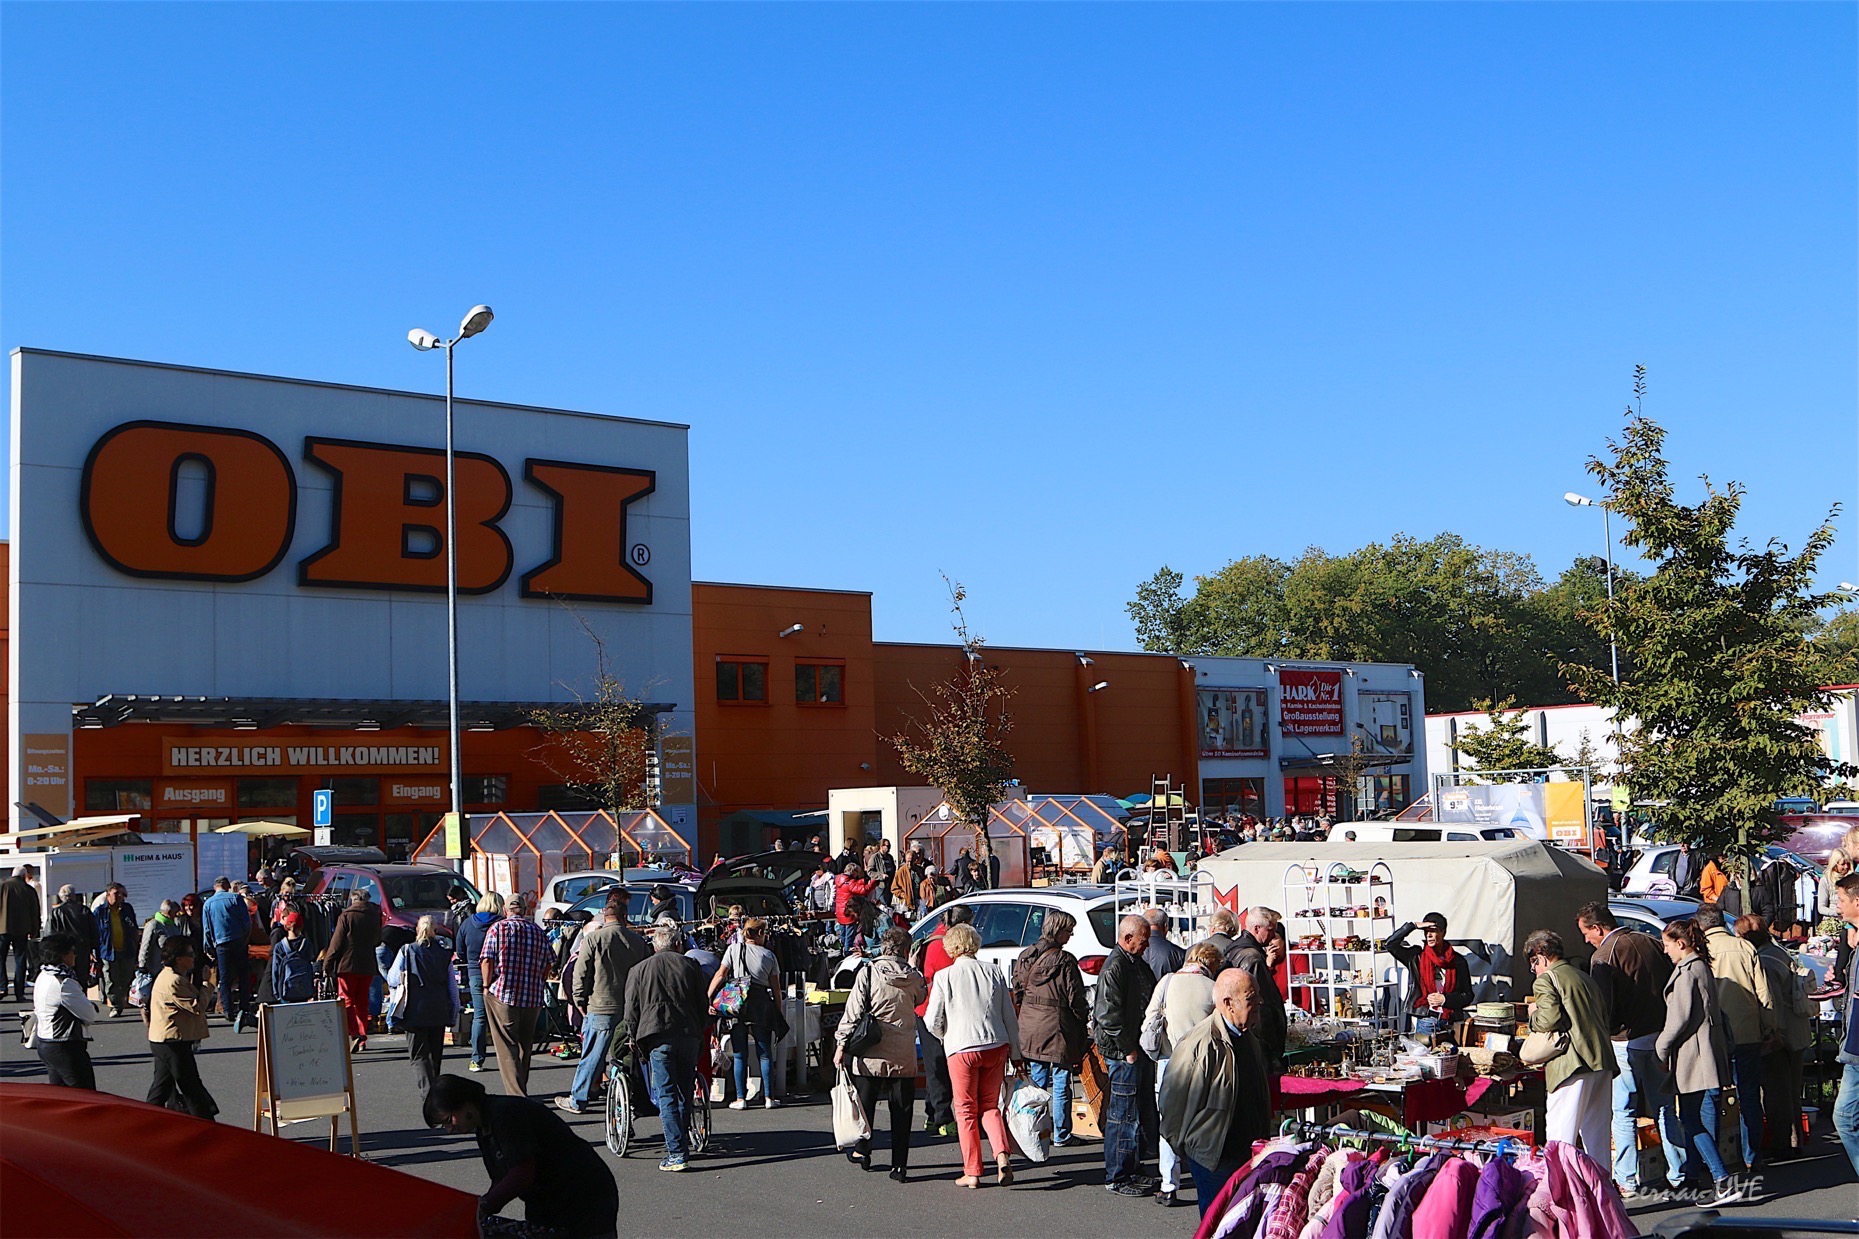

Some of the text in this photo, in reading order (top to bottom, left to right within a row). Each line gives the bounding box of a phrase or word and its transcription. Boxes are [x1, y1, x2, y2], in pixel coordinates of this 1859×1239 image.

[80, 419, 656, 605] OBI
[1280, 684, 1316, 701] HARK
[1283, 711, 1340, 721] Großausstellung
[1295, 724, 1341, 734] Lagerverkauf
[171, 746, 441, 767] HERZLICH WILLKOMMEN!
[28, 765, 65, 773] Mo.-Sa.:
[50, 777, 66, 785] Uhr
[163, 786, 226, 804] Ausgang
[392, 784, 441, 799] Eingang
[317, 794, 327, 822] P
[1555, 829, 1577, 837] OBI
[135, 854, 154, 862] HEIM
[162, 853, 183, 861] HAUS
